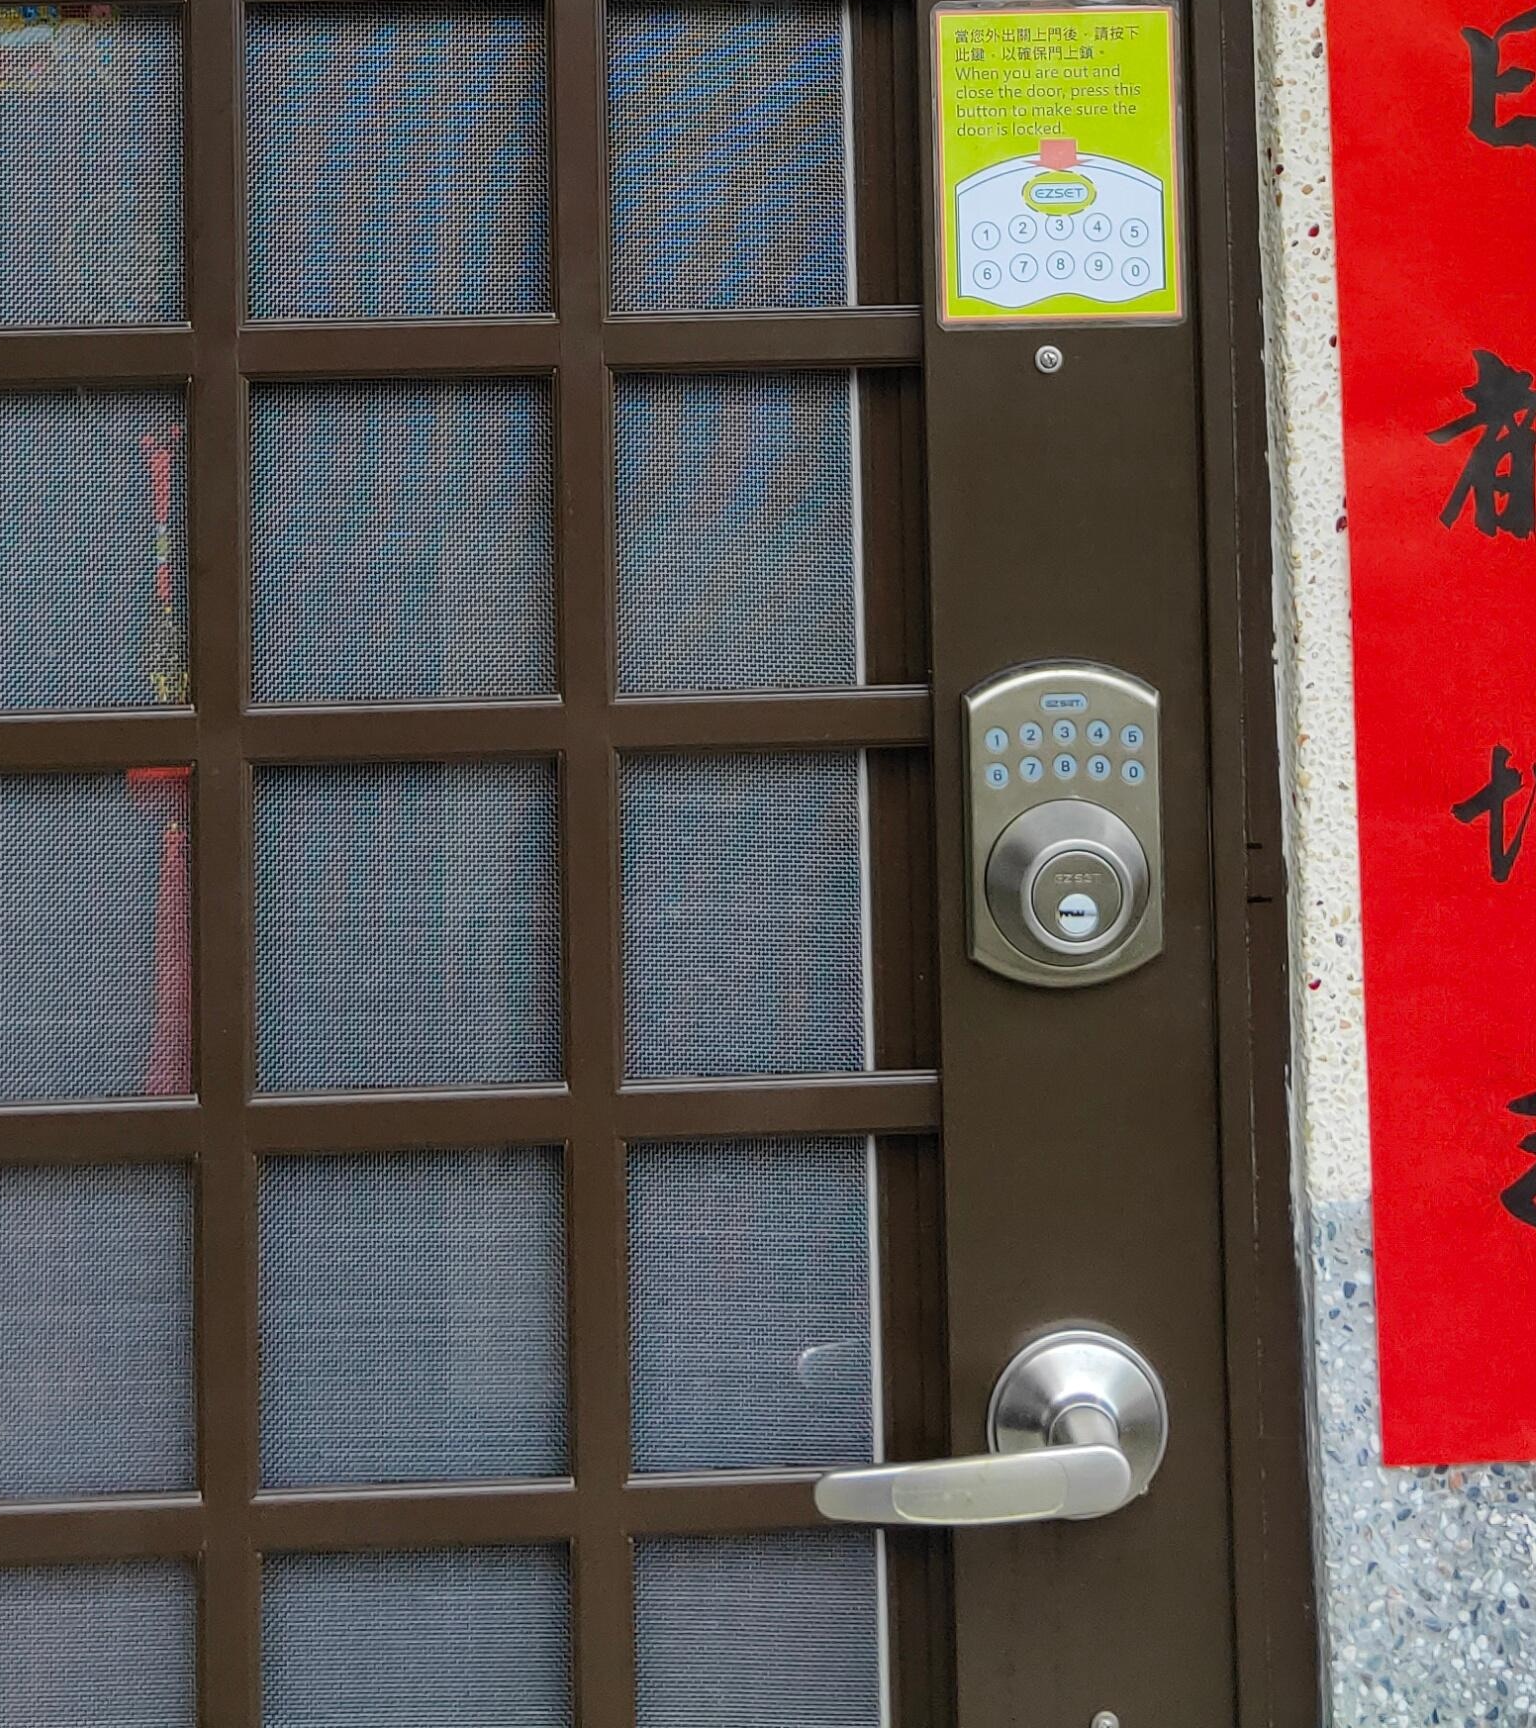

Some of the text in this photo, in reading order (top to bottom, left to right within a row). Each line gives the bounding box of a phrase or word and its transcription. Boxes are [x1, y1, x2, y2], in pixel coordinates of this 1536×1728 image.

[955, 64, 1120, 83] When you are out and
[955, 83, 1141, 103] close the door, press this
[956, 101, 1137, 119] button to make sure the
[956, 123, 993, 137] door
[996, 123, 1008, 137] is
[1034, 187, 1085, 199] EZSET
[983, 219, 1139, 242] 1 2 3 4 5
[983, 258, 1140, 280] 6 7 8 9 0
[994, 726, 1137, 747] 1 2 3 4 5
[993, 760, 1138, 781] 6 7 8 9 0
